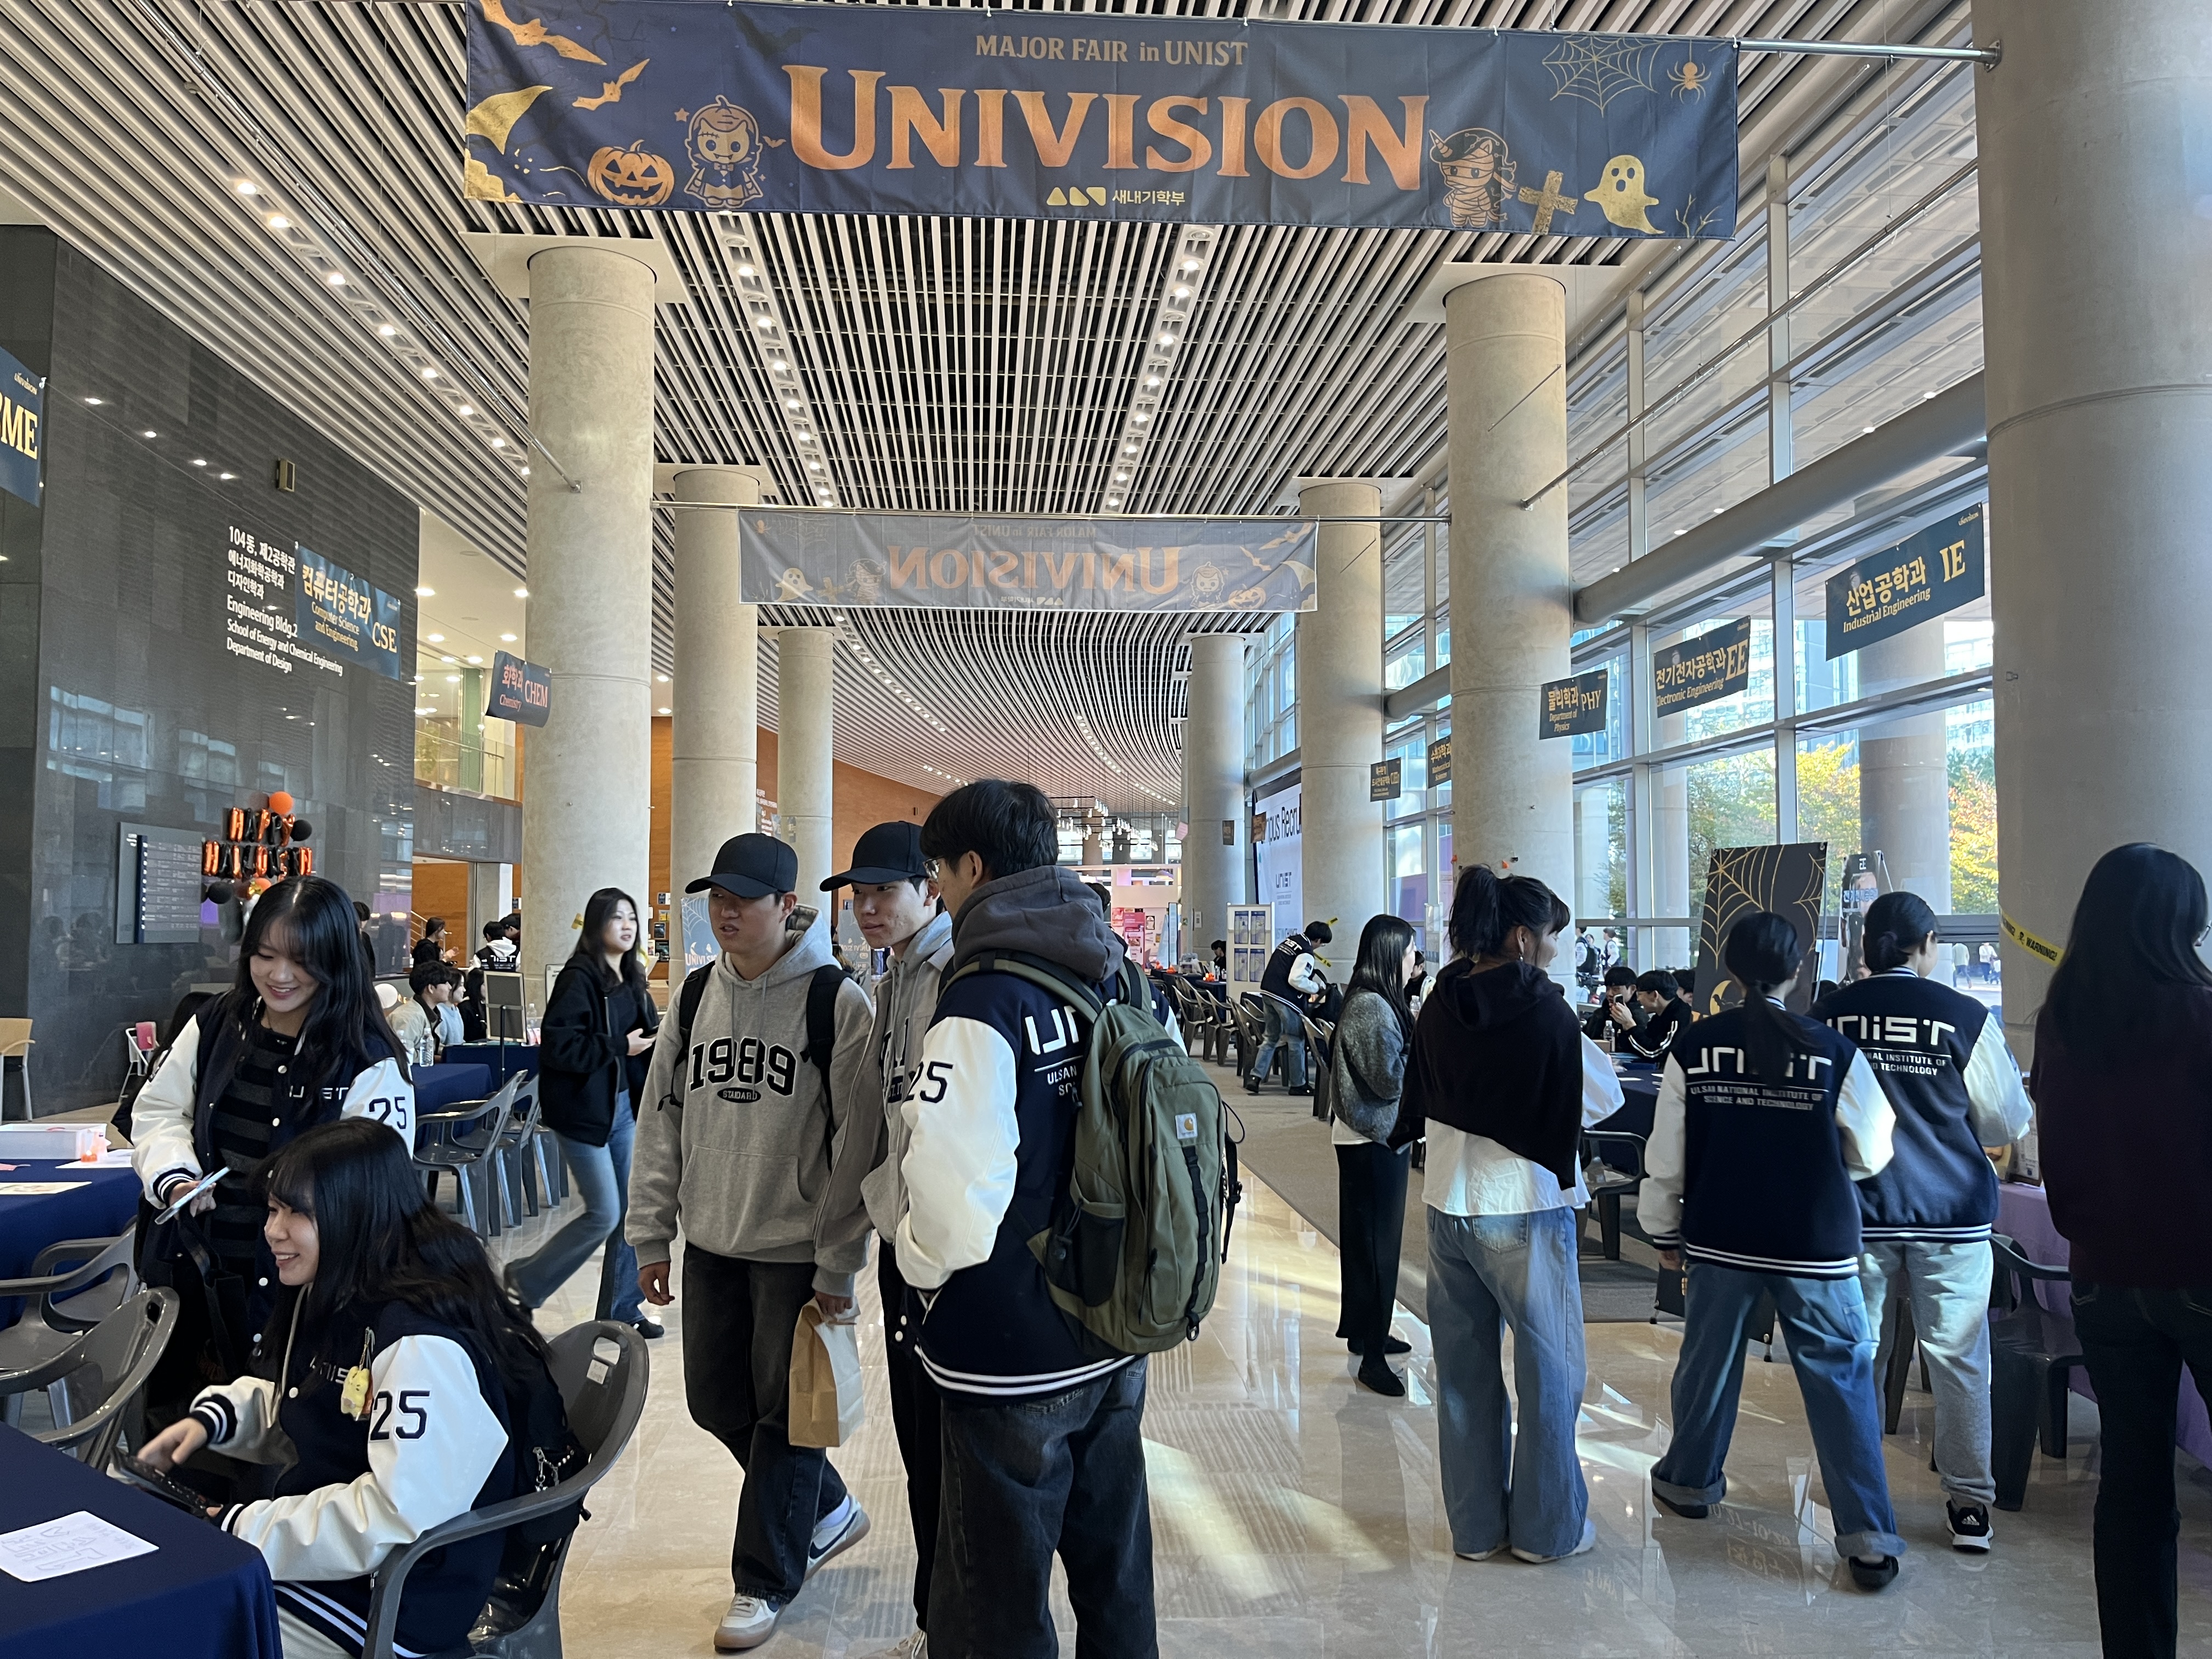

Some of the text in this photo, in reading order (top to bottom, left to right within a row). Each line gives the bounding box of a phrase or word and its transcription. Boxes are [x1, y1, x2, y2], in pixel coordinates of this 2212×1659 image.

[976, 35, 1248, 66] MAJOR FAIR in UNIST
[781, 64, 1430, 190] UNIVISION
[1112, 189, 1186, 206] 새내기학부
[0, 390, 38, 460] ME
[229, 526, 296, 575] 104동, 제2공학관
[1939, 540, 1966, 583] IE
[228, 549, 284, 590] 에너지화학공학과
[228, 569, 264, 600] 디자인학과
[1846, 556, 1926, 617] 산업공학과
[302, 565, 372, 625] 컴퓨터공학과
[1843, 588, 1931, 633] Industrial Engineering
[227, 594, 298, 639] Engineering Bldg.2
[312, 601, 360, 635] Computer Science
[227, 618, 343, 676] School of Energy and Chemical Engineering
[325, 625, 359, 652] Engineering
[372, 622, 398, 653] CSE
[227, 637, 292, 674] Department of Design
[1656, 647, 1726, 690] 전기전자공학과
[1725, 639, 1748, 681] EE
[502, 664, 523, 692] 화학과
[524, 680, 548, 708] CHEM
[1656, 677, 1724, 708] Electronic Engineering
[500, 694, 522, 712] Chemistry
[1548, 686, 1579, 712] 물리학과
[1581, 690, 1601, 711] PHY
[690, 1036, 797, 1097] 1989
[1047, 1065, 1077, 1085] ULSAN
[1881, 1063, 1937, 1076] TECHNOLOGY
[1886, 1053, 1933, 1065] INSTITUTE
[723, 1090, 758, 1101] STANDARD
[904, 1061, 953, 1103] 25
[1690, 1085, 1716, 1095] ULSAN
[1717, 1086, 1760, 1096] NATIONAL
[1762, 1088, 1809, 1101] INSTITUTE
[369, 1096, 407, 1130] 25
[1735, 1097, 1754, 1105] AND
[370, 1390, 431, 1441] 25
